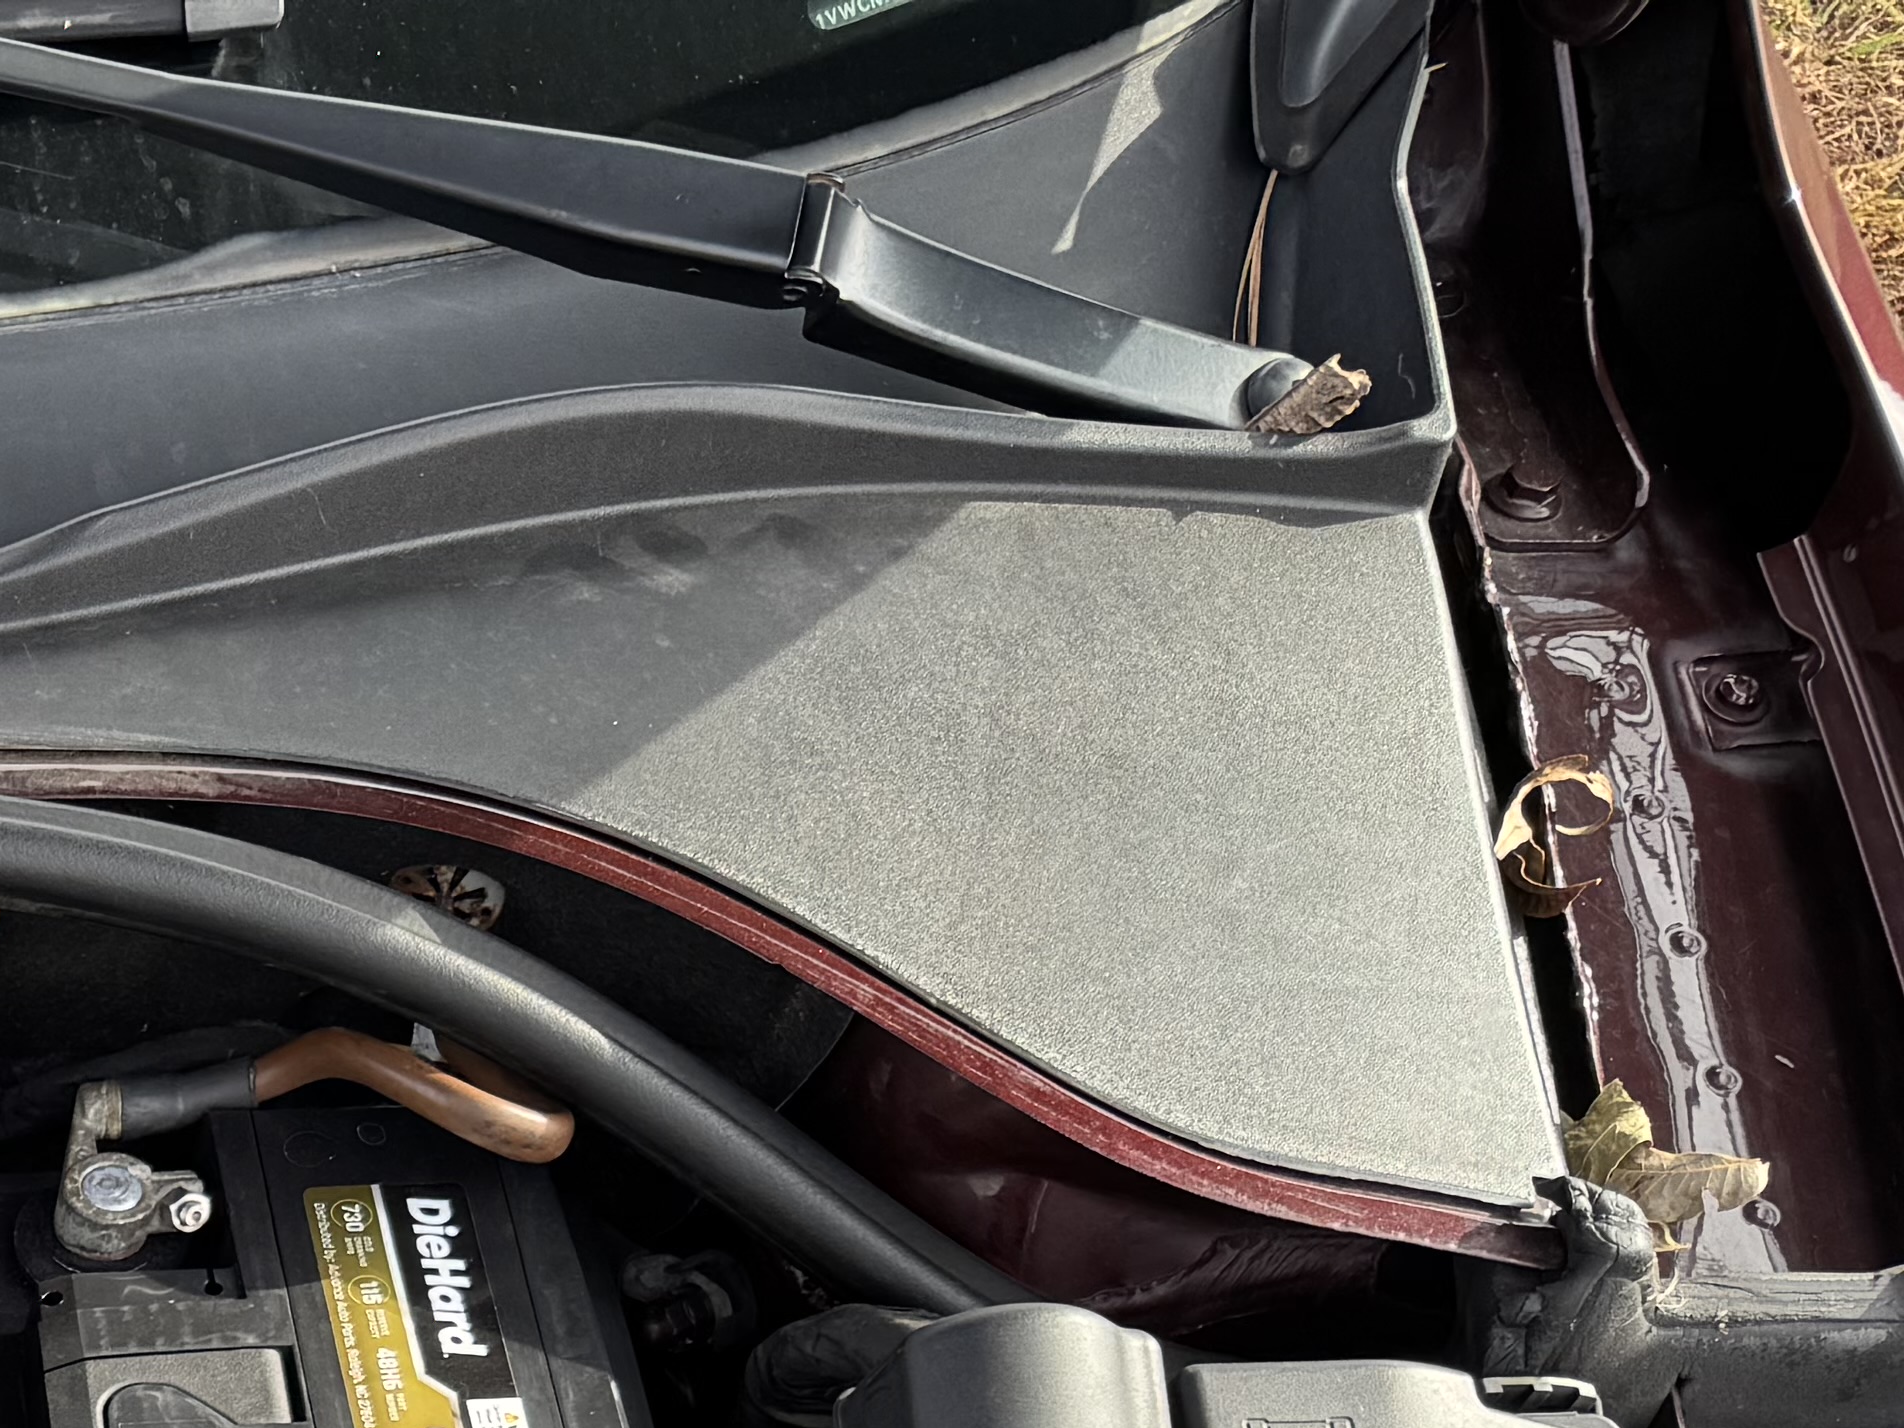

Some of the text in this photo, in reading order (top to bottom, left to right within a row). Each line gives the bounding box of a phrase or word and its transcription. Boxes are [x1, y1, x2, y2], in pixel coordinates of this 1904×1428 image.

[341, 1202, 365, 1233] 730
[406, 1197, 489, 1357] DieHard
[376, 1346, 403, 1392] 48H6
